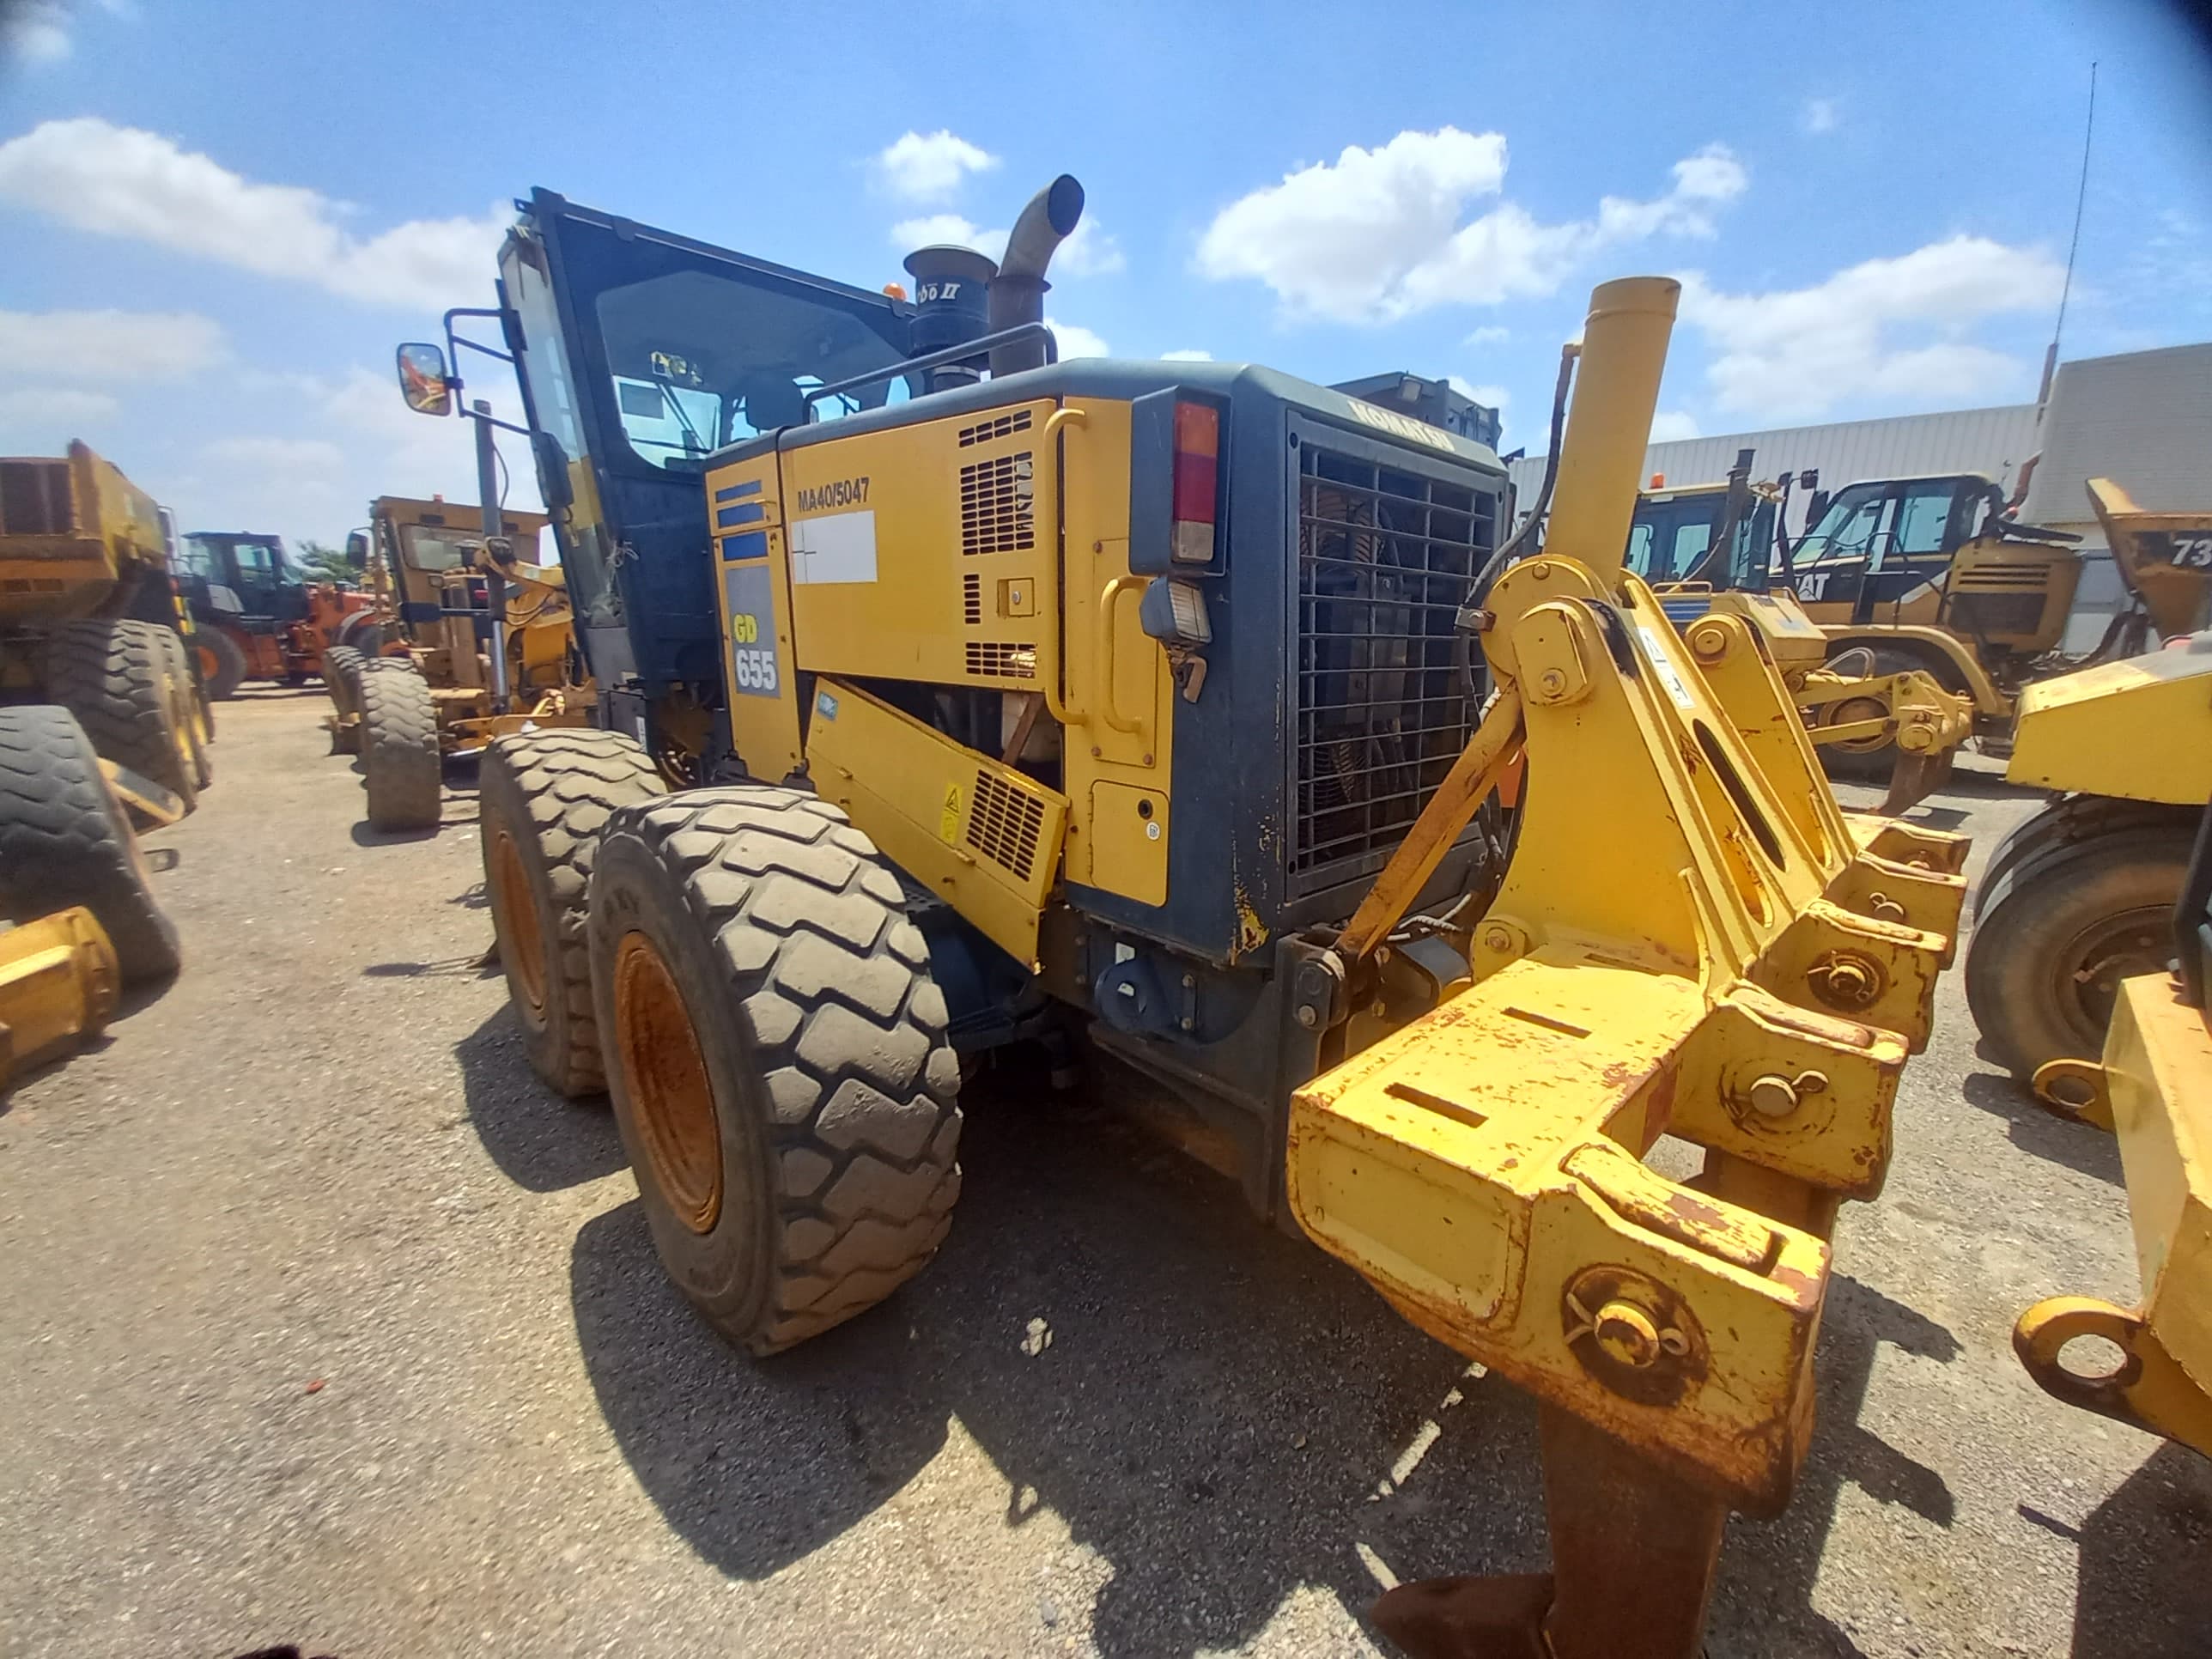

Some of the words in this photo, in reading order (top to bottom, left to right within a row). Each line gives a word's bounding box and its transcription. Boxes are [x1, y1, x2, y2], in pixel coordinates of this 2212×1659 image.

[1346, 399, 1455, 453] KOMATSU
[798, 477, 869, 514] MA40/5047
[2172, 538, 2212, 566] 73
[734, 614, 757, 644] GD
[736, 649, 777, 690] 655
